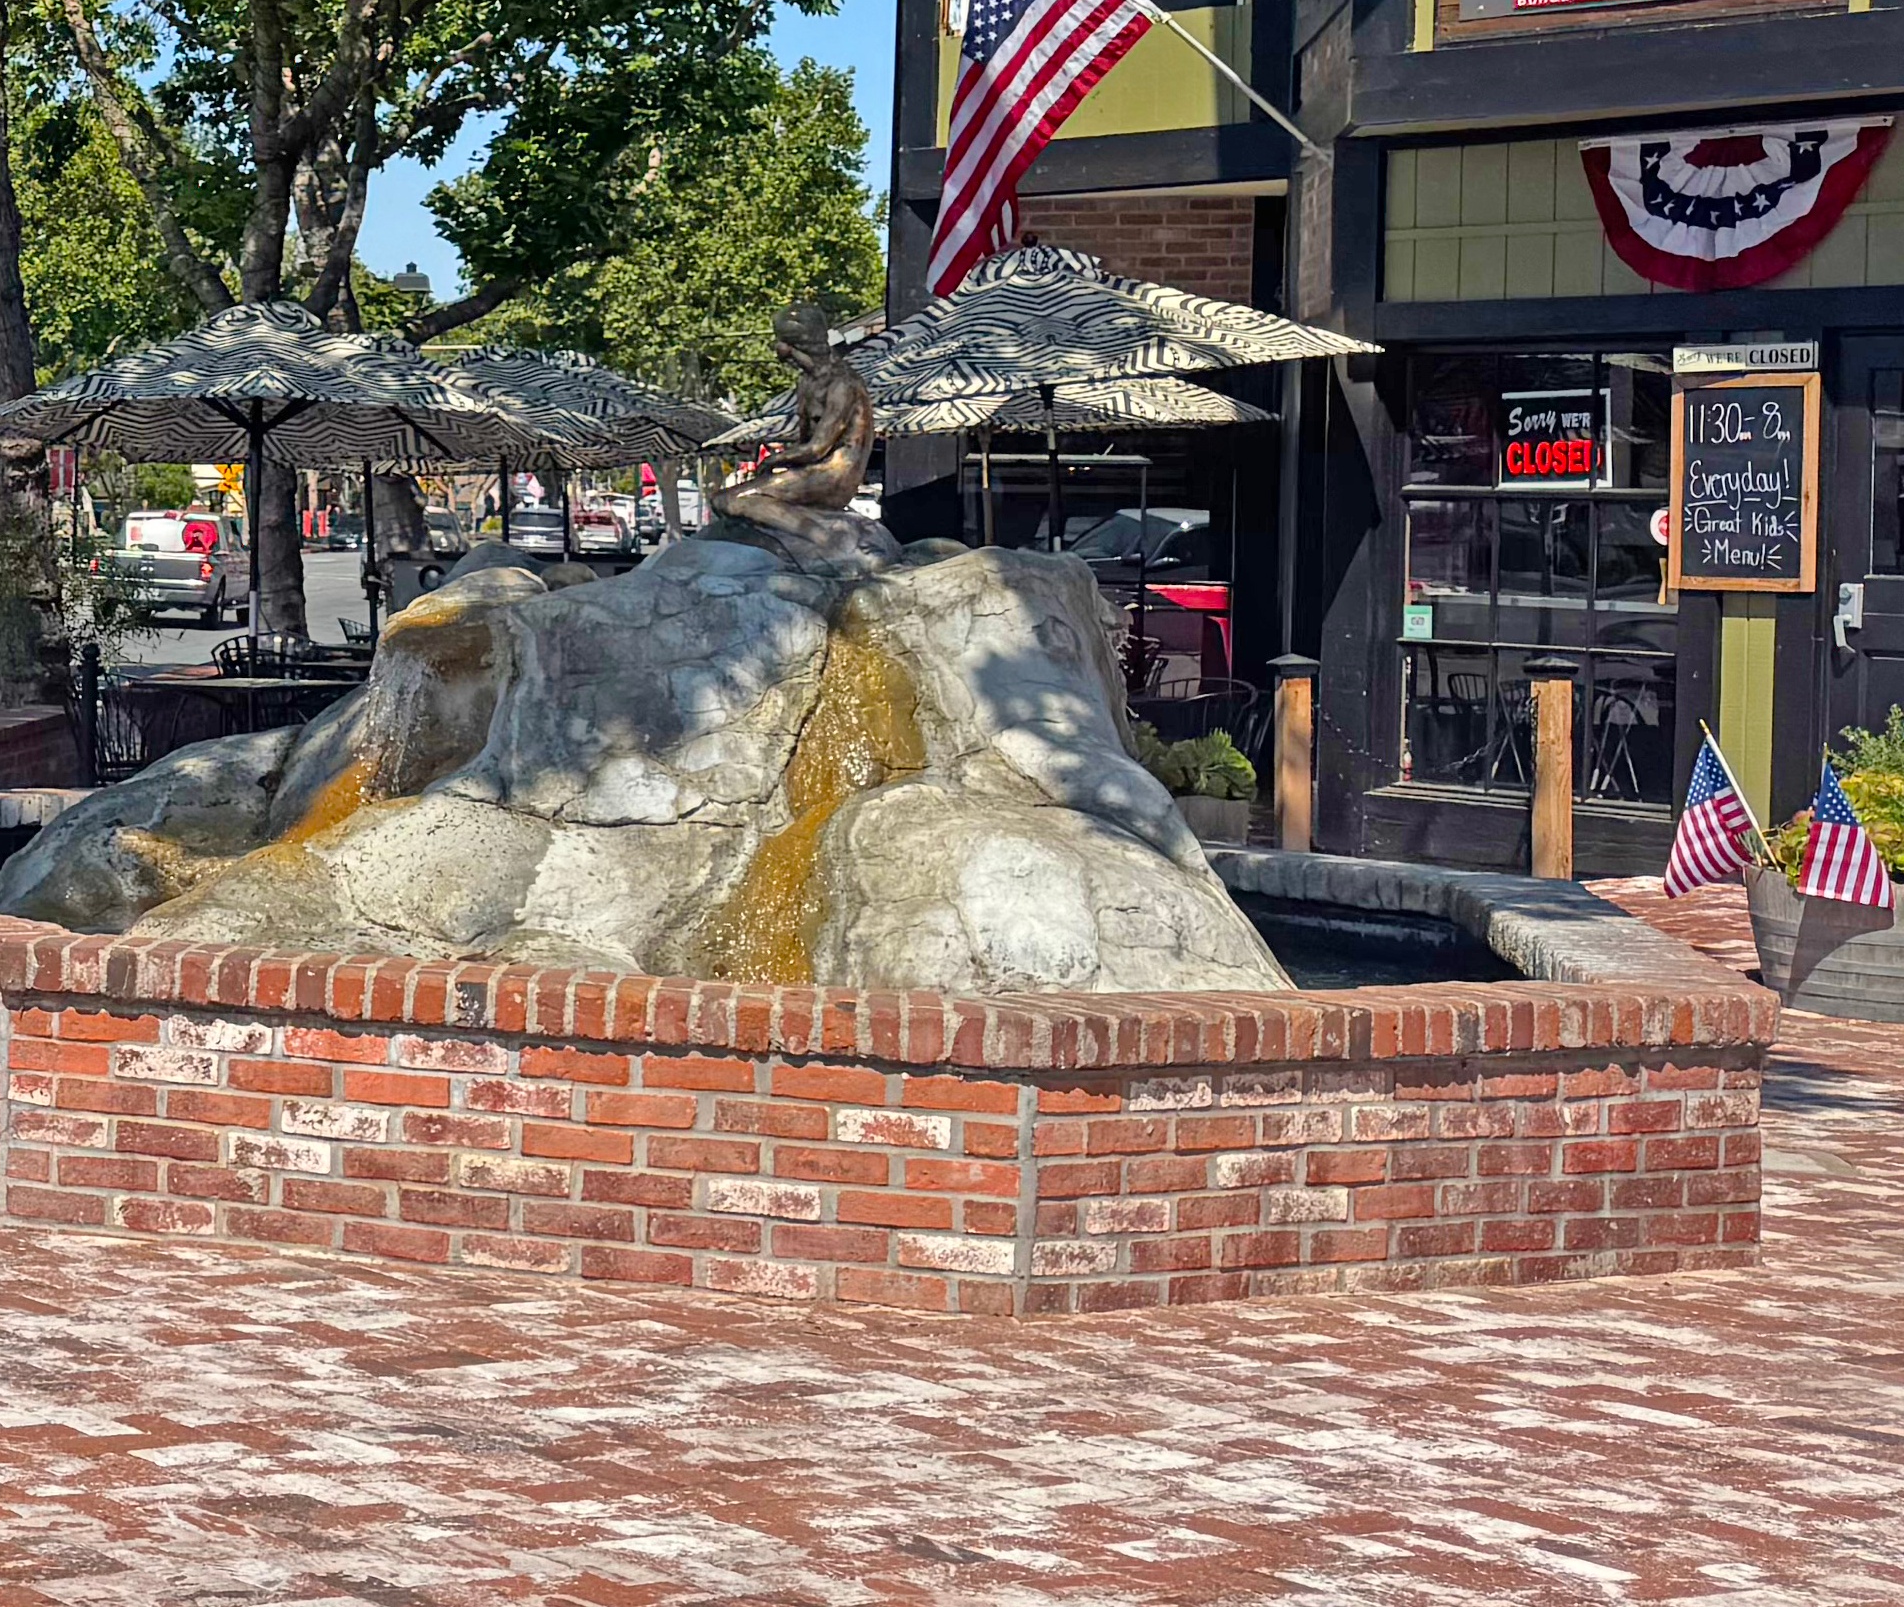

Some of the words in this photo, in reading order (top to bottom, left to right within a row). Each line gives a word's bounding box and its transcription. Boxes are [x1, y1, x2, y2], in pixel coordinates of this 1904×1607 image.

[1749, 347, 1811, 365] CLOSED
[1508, 407, 1557, 436] Sorry
[1689, 458, 1791, 510] Everyday!
[1694, 506, 1742, 534] Great
[1751, 511, 1785, 537] Kids
[1714, 538, 1766, 570] Menu!
